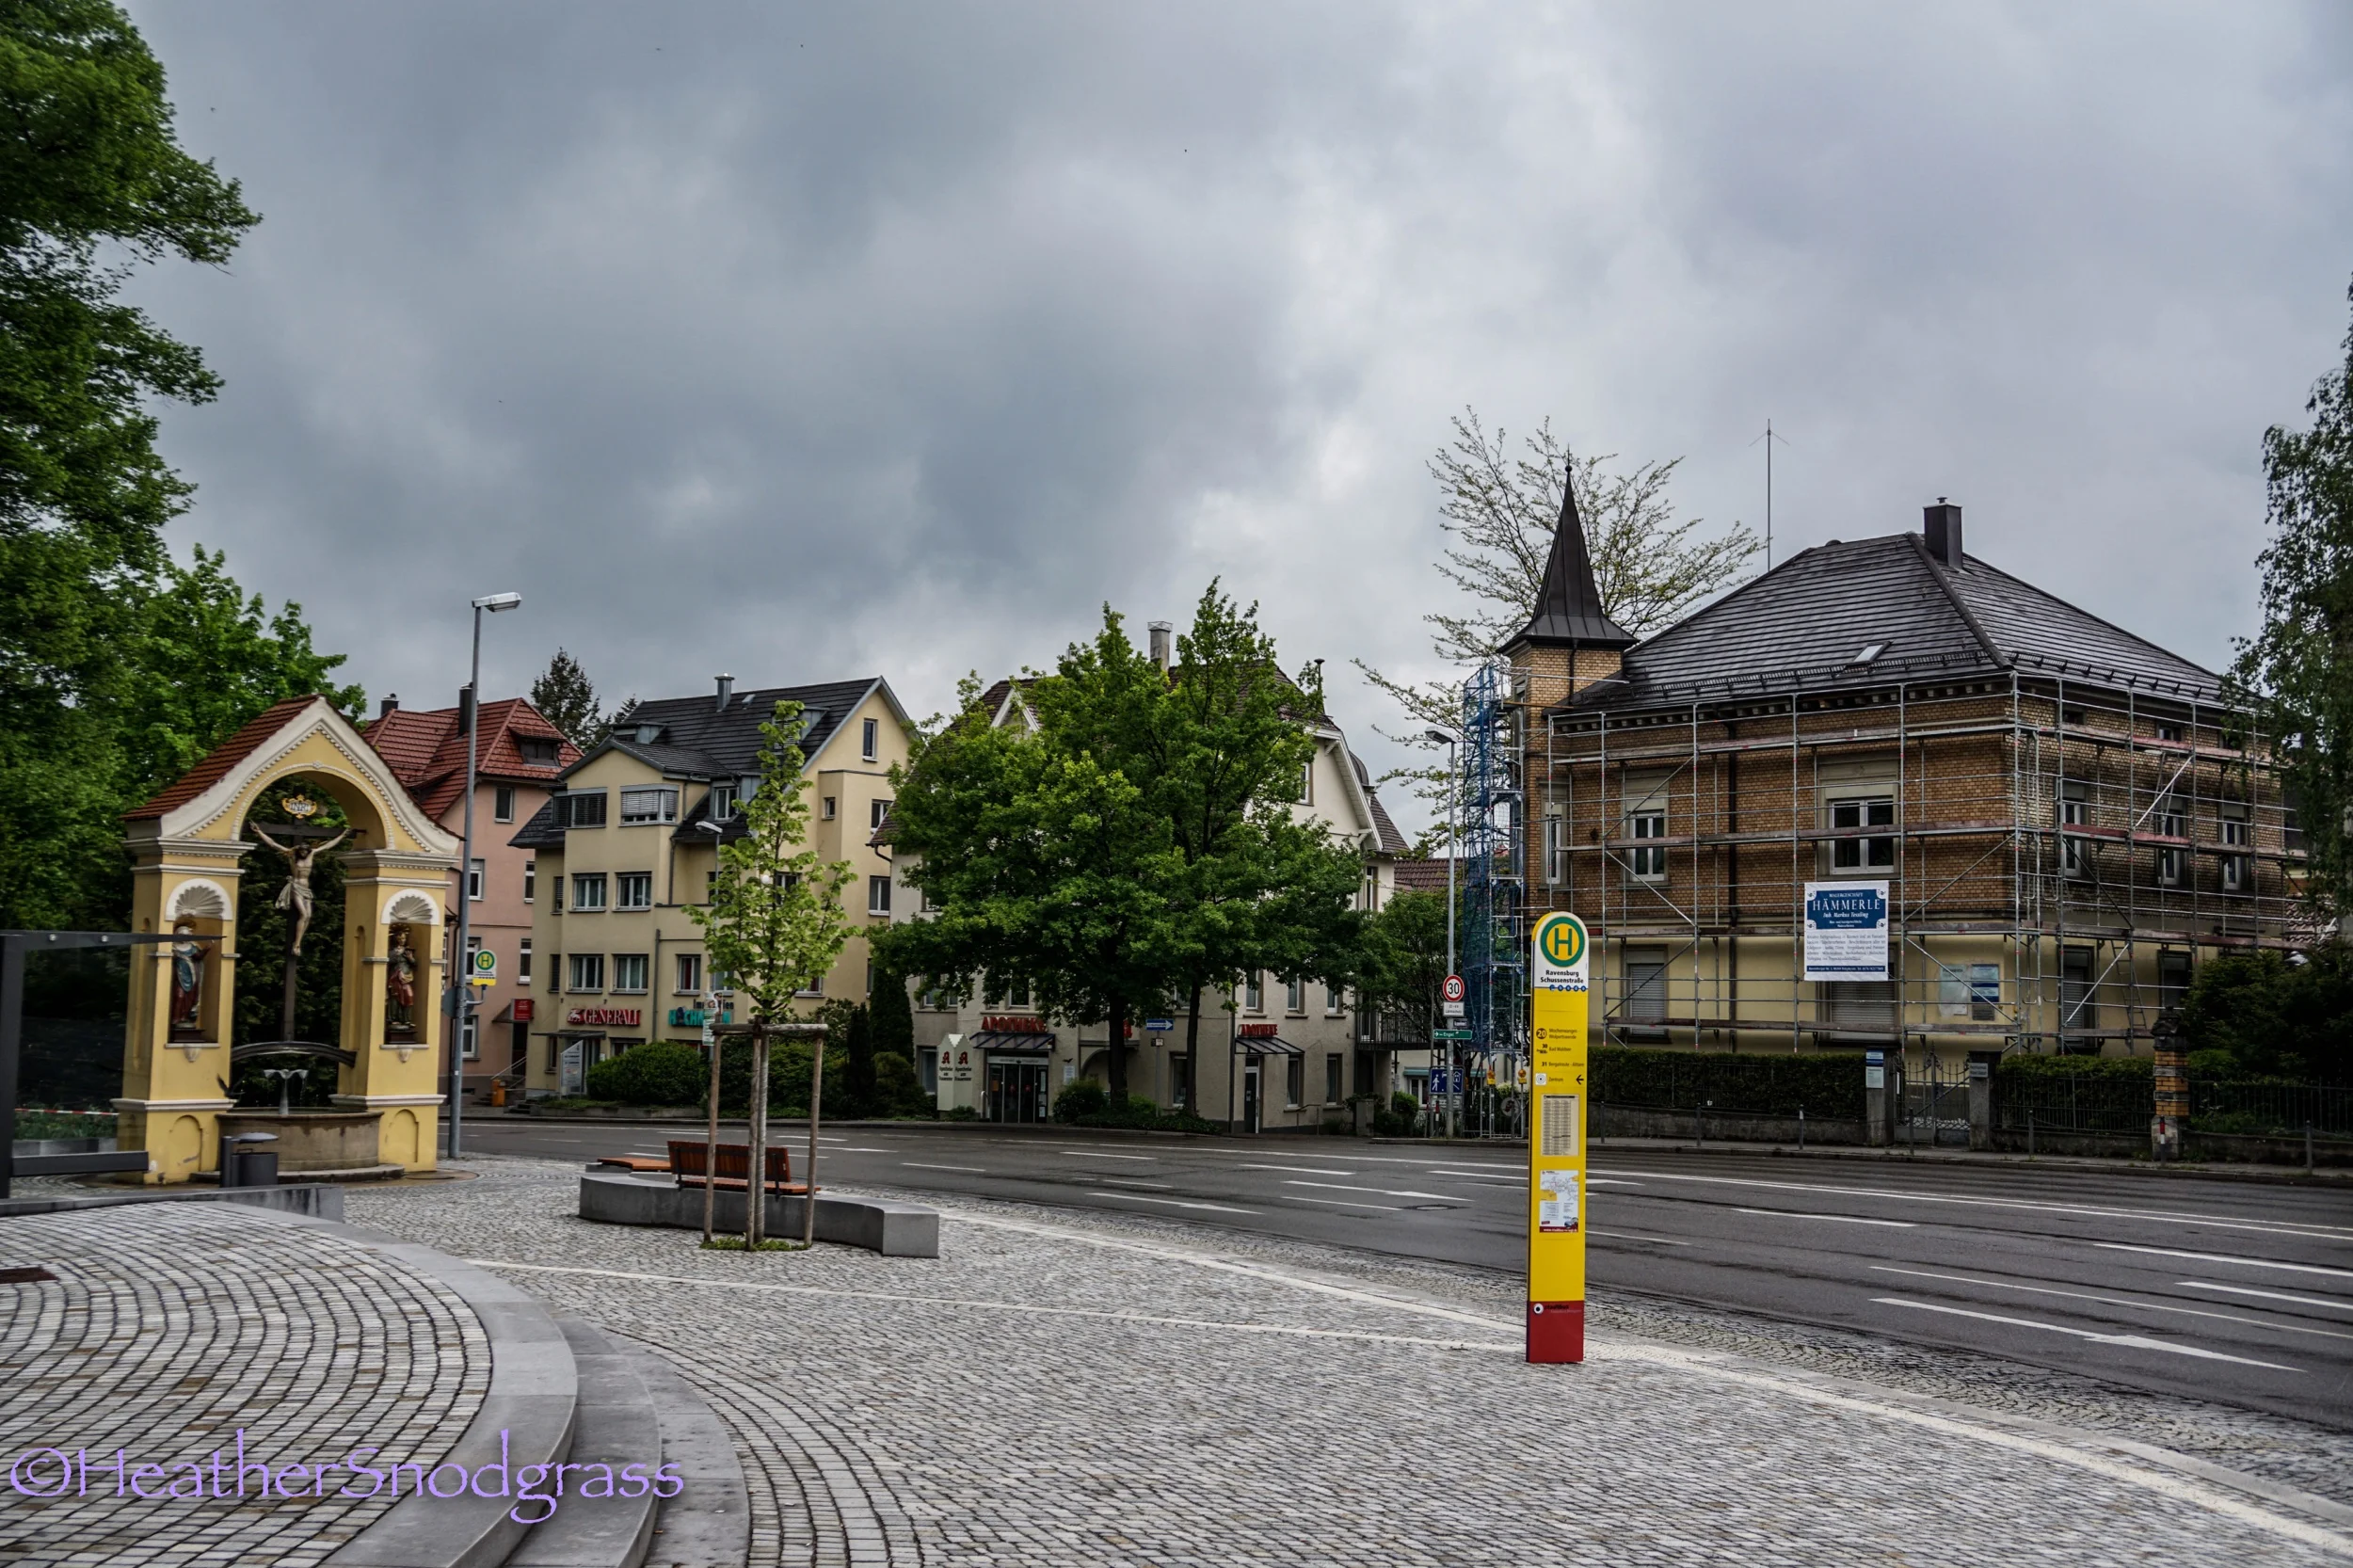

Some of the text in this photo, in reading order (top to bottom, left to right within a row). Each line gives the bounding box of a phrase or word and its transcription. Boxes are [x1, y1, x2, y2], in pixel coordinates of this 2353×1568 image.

[1813, 898, 1881, 911] HÄMMERLE
[1554, 927, 1573, 956] H
[481, 955, 489, 967] H
[1448, 983, 1460, 995] 30
[584, 1008, 640, 1025] GENERALI
